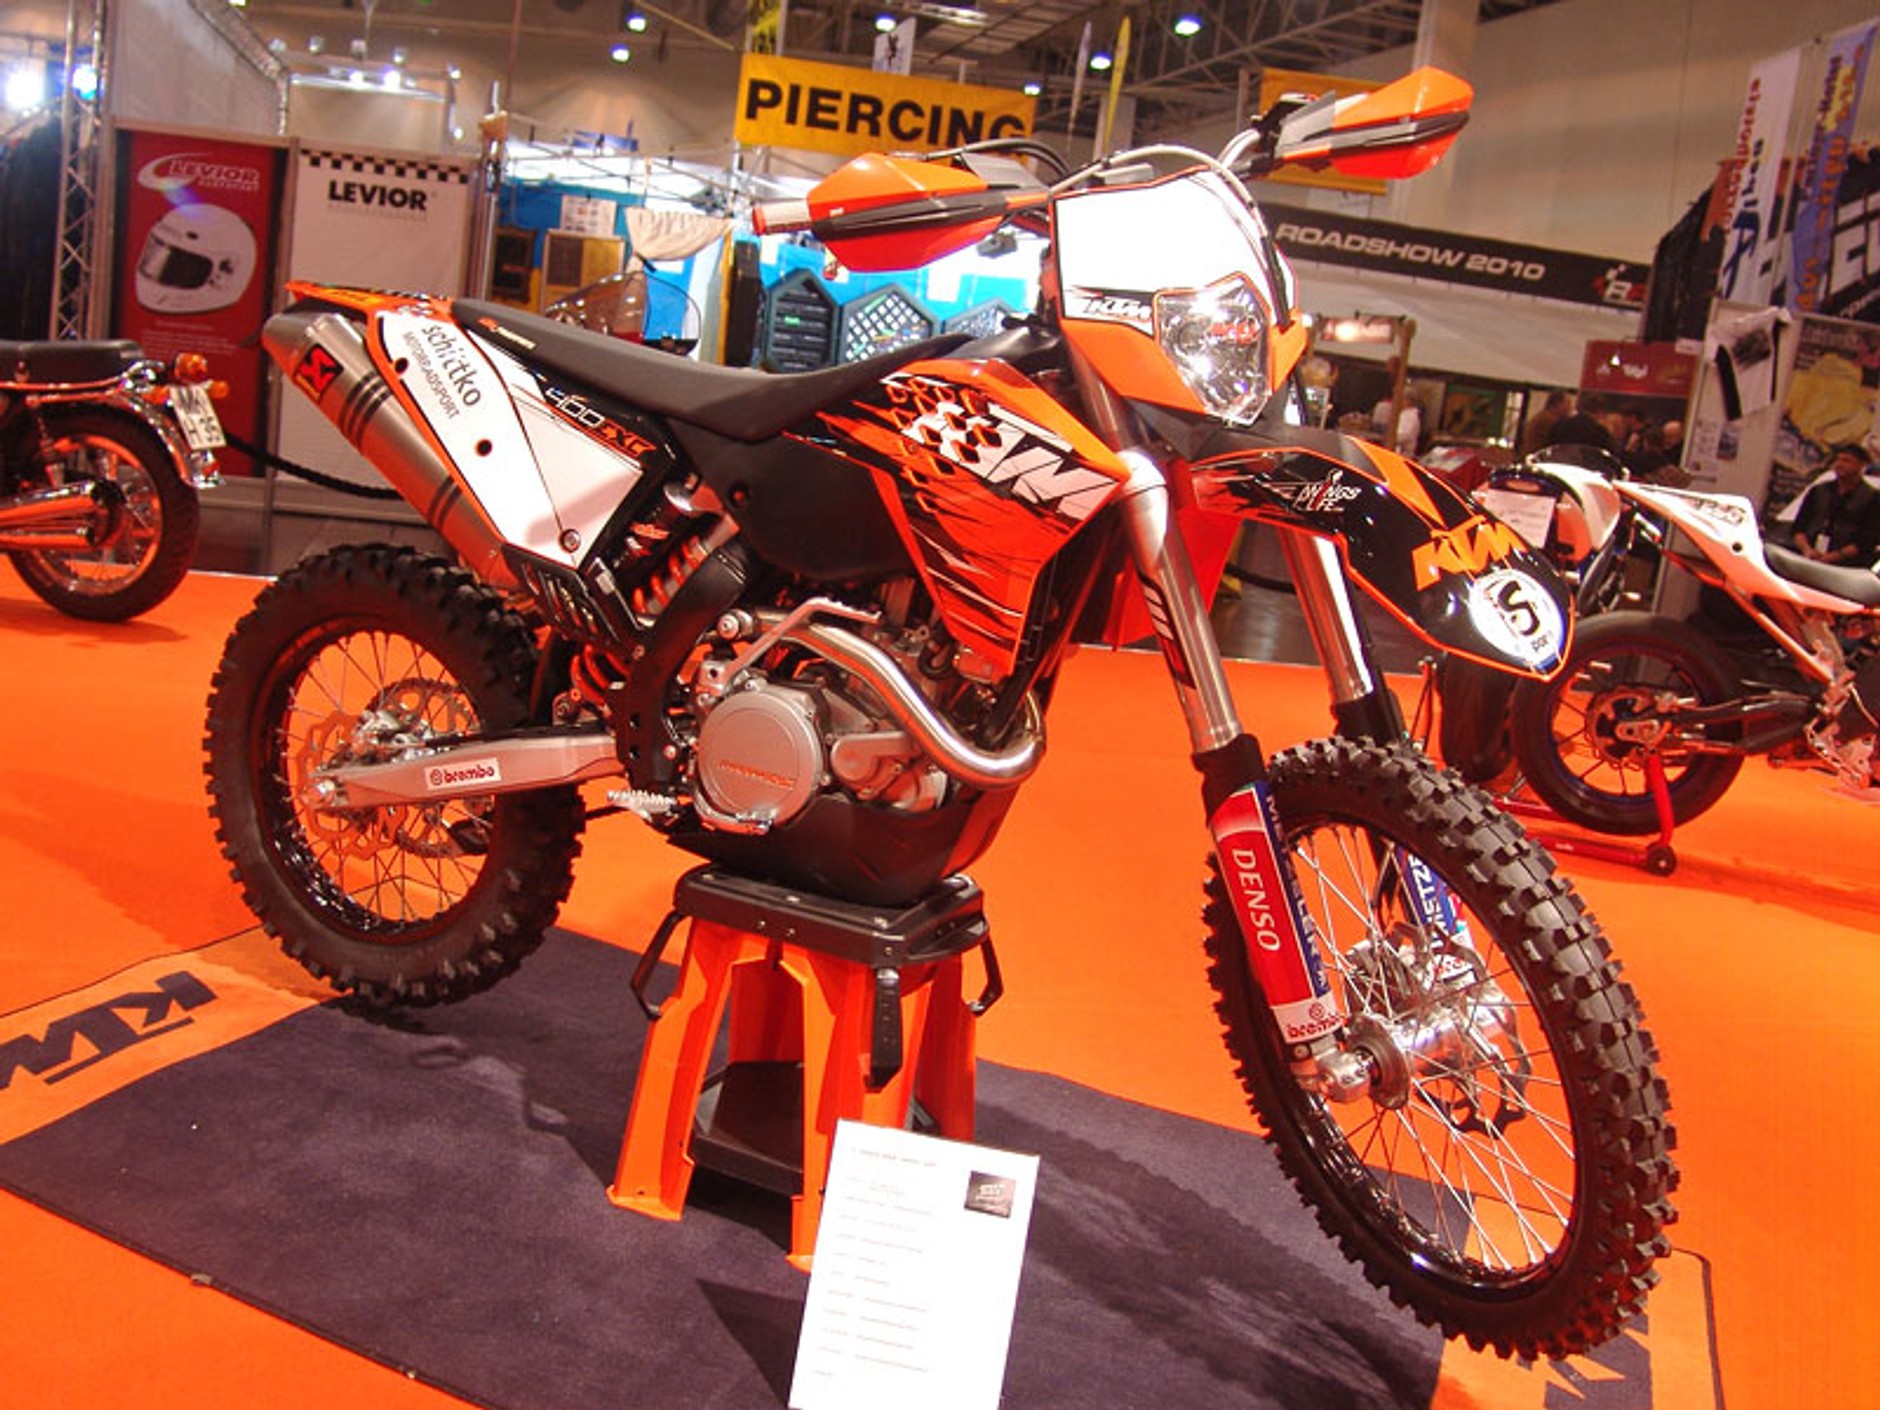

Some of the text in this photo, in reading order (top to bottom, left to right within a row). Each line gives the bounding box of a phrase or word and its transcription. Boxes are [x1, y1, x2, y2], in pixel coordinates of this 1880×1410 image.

[744, 78, 1027, 150] PIERCING
[167, 160, 260, 184] LEVIOR
[328, 180, 428, 211] LEVIOR
[1274, 222, 1547, 281] ROADSHOW 2010
[1412, 515, 1528, 592] KTM
[443, 763, 495, 784] brembo
[1232, 849, 1281, 951] DENSO
